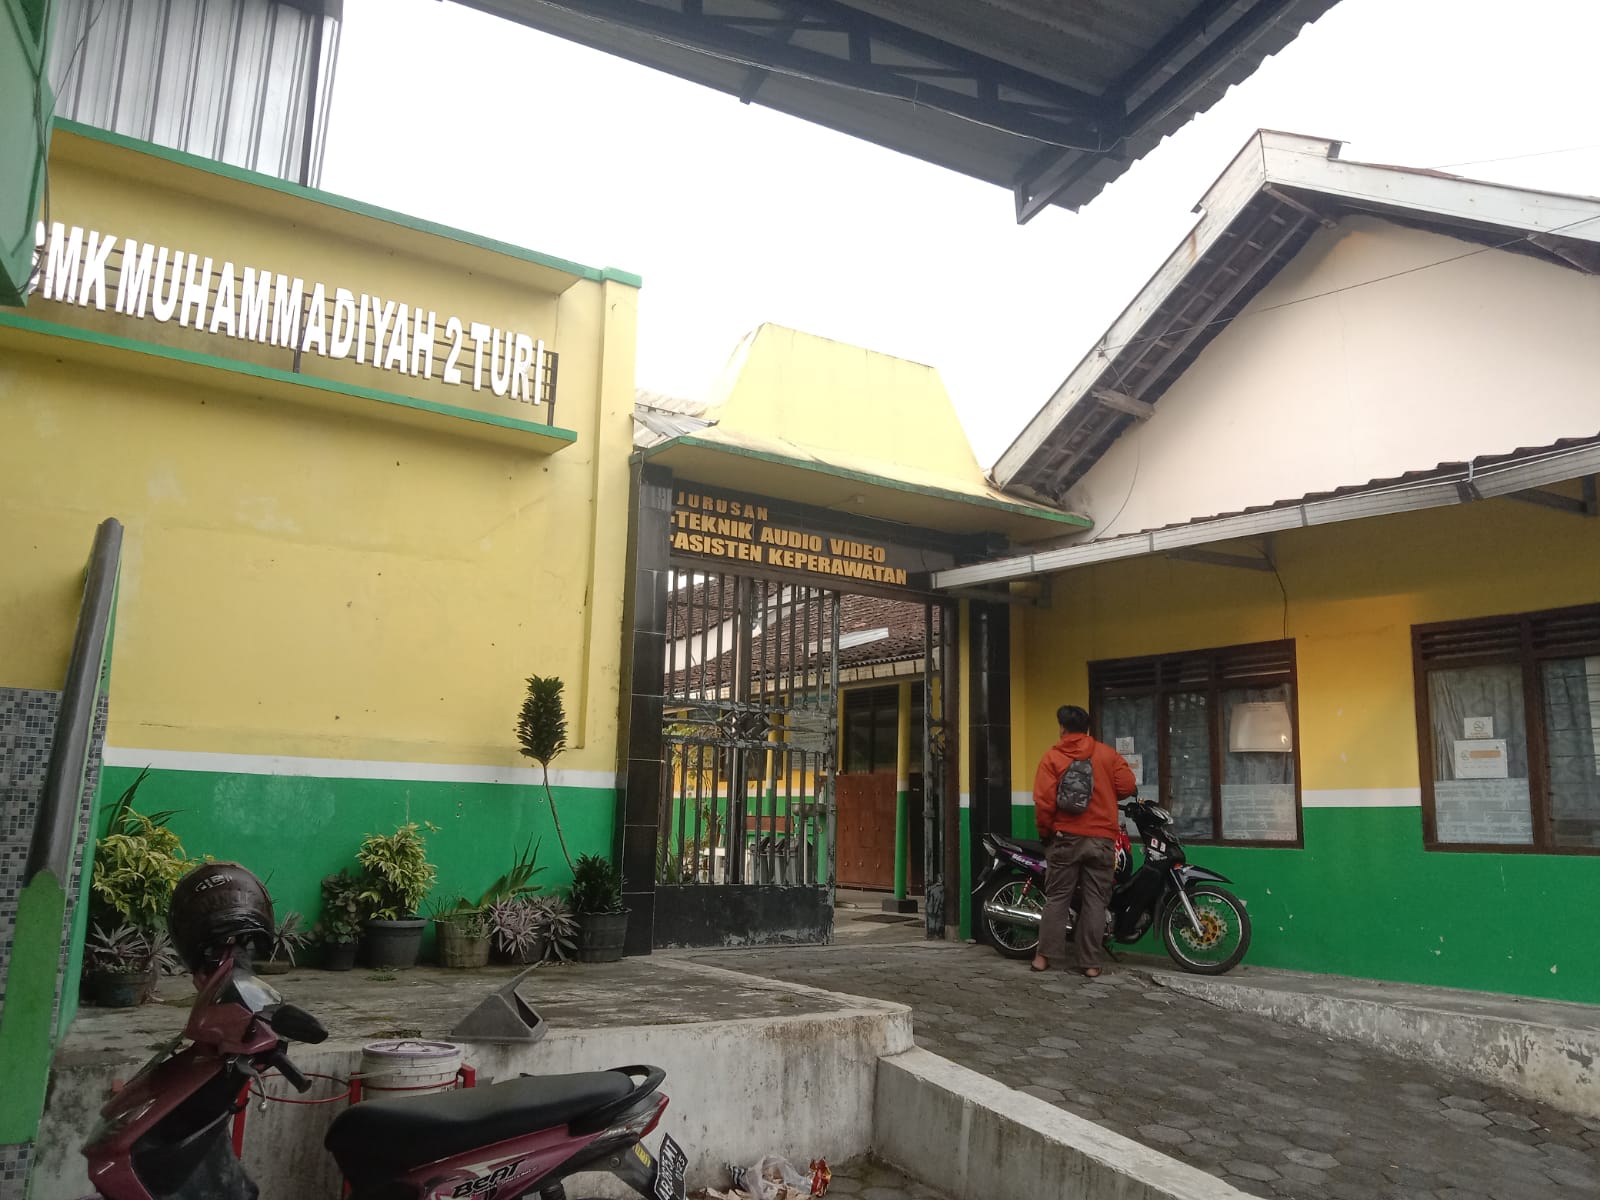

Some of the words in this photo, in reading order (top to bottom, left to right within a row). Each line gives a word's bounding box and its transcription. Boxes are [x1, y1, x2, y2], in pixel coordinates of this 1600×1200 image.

[115, 238, 436, 379] MUHAMMADIYAH
[443, 316, 463, 385] 2
[470, 321, 545, 405] TURI
[677, 491, 768, 521] JURUSAN
[673, 531, 762, 563] ASISTEN
[768, 547, 907, 585] KEPERAWATAN
[675, 510, 753, 540] TEKNIK
[760, 526, 822, 553] AUDIO
[829, 537, 886, 563] VIDEO
